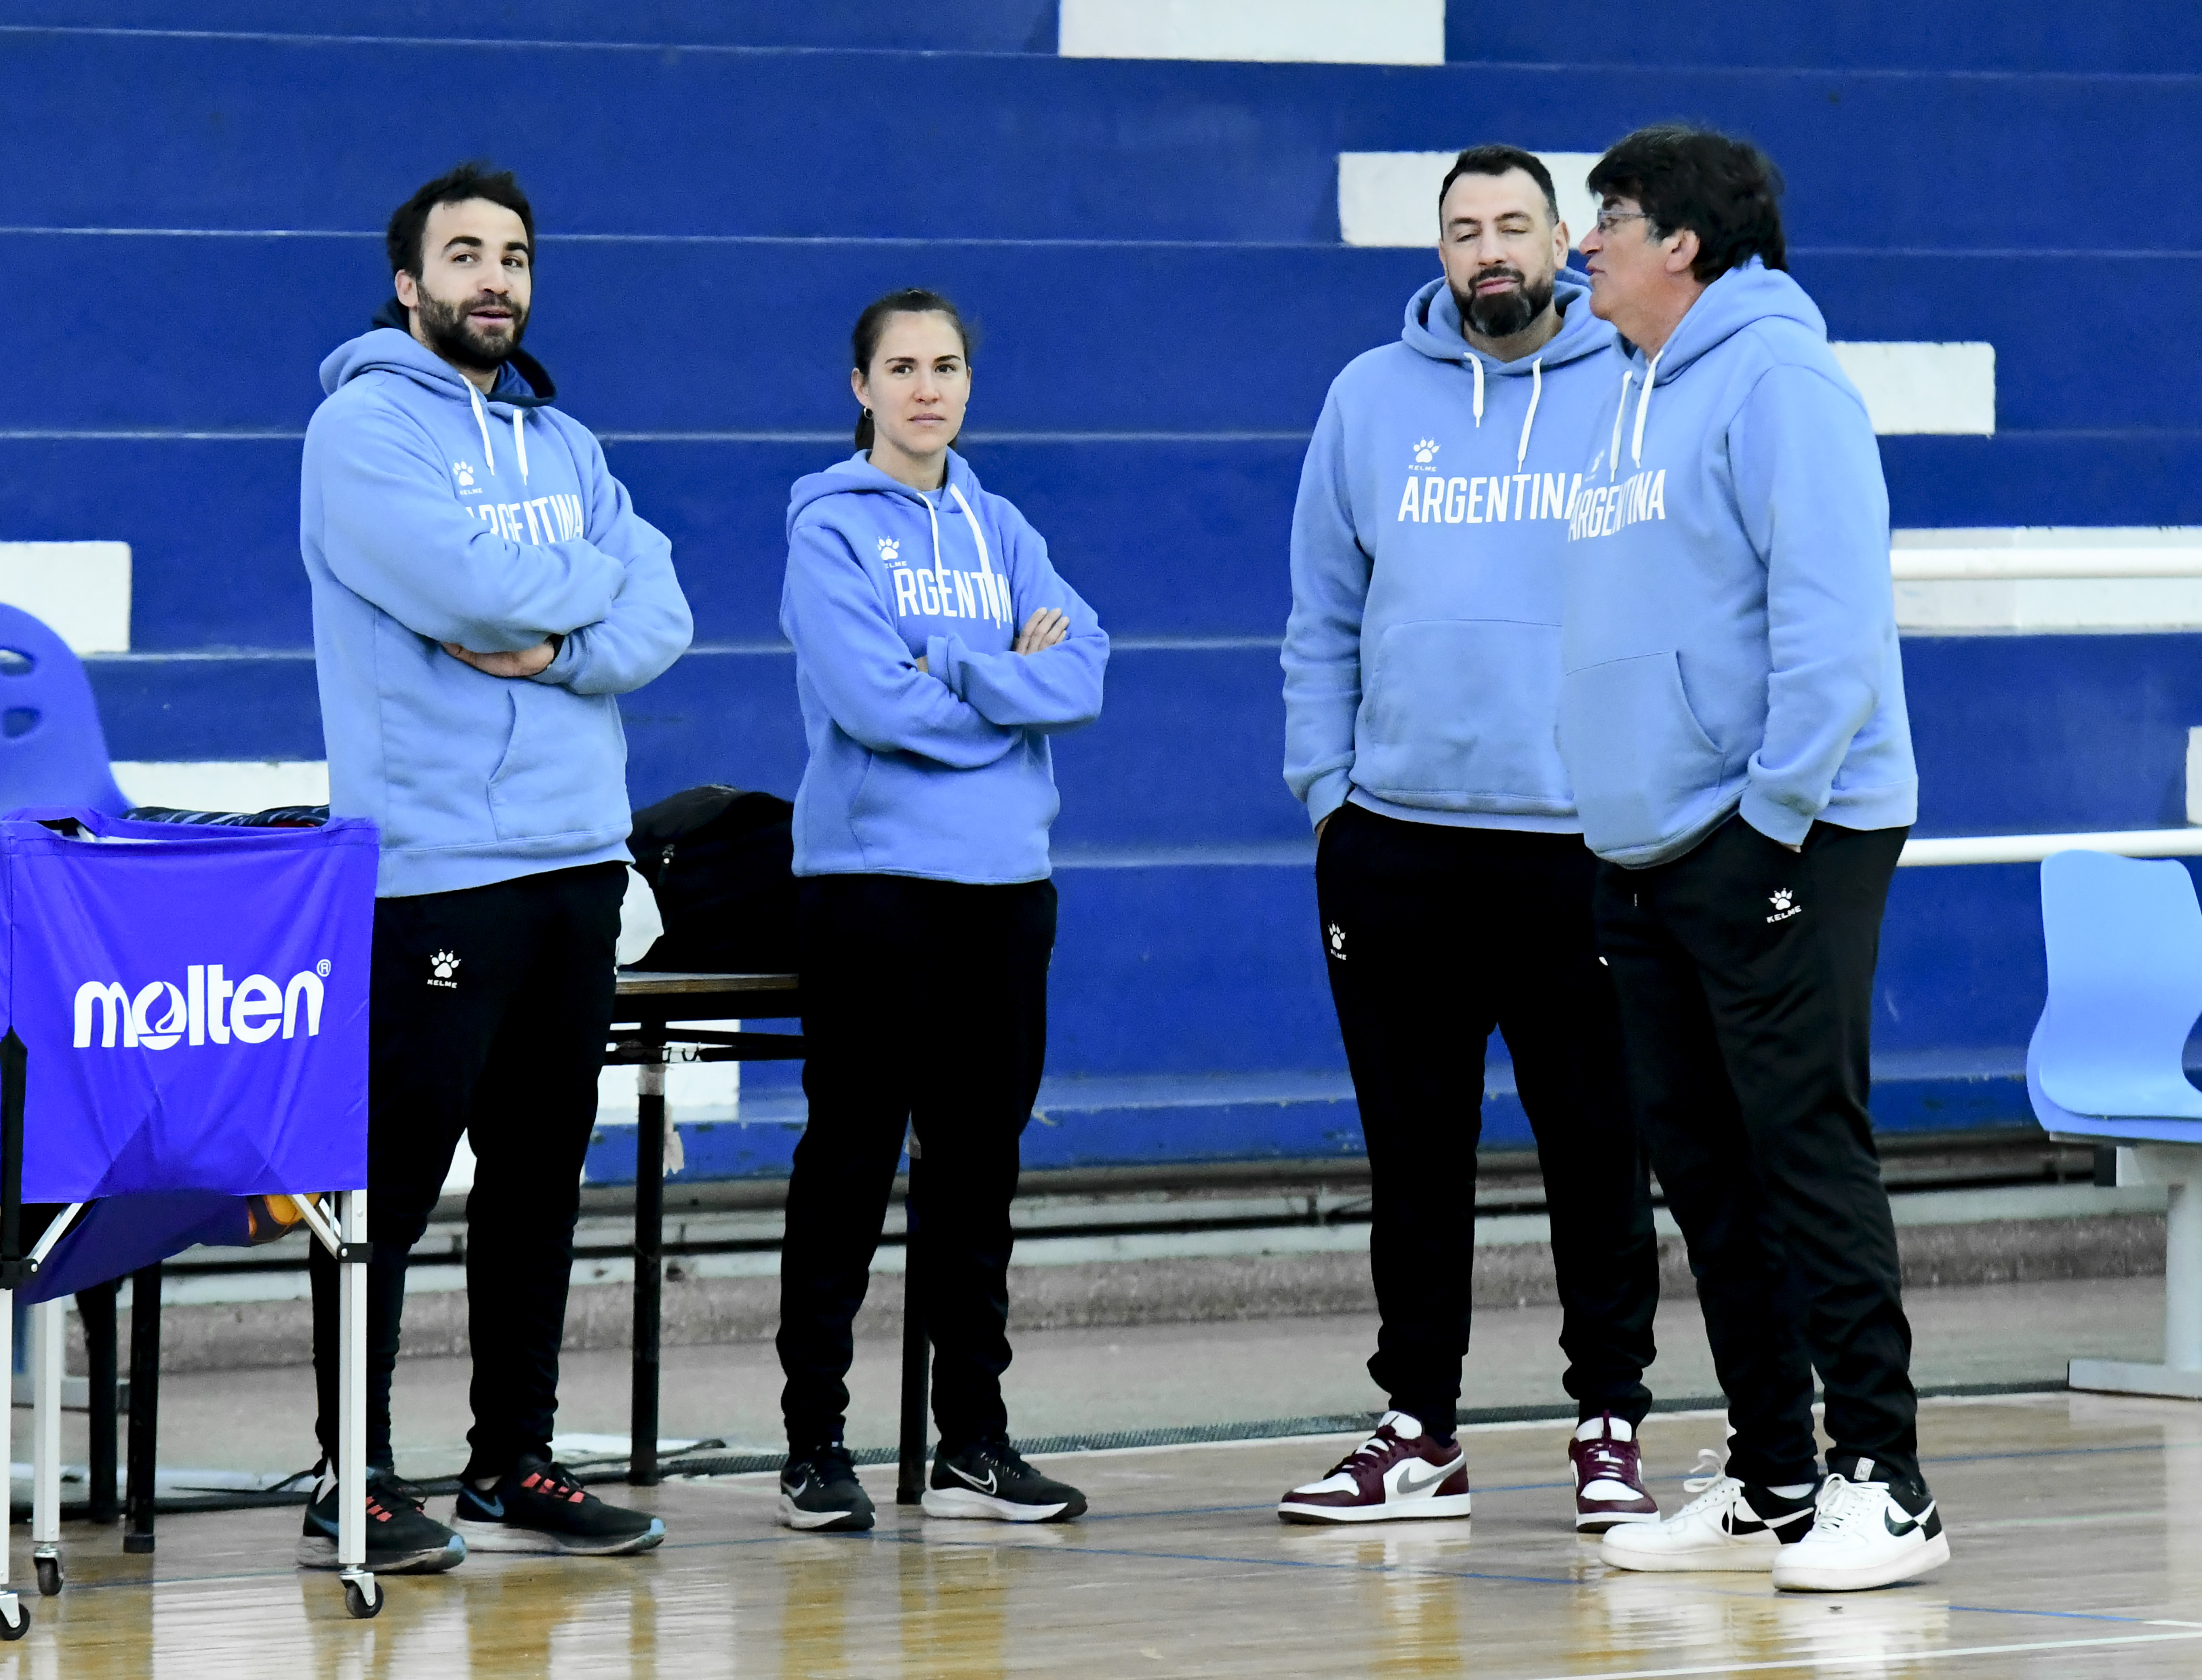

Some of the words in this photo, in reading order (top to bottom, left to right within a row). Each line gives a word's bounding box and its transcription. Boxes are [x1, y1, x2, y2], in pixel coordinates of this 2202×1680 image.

[465, 494, 584, 546] RGENTINA
[1766, 905, 1801, 923] KELME
[427, 979, 457, 989] KELME
[73, 964, 324, 1050] molten
